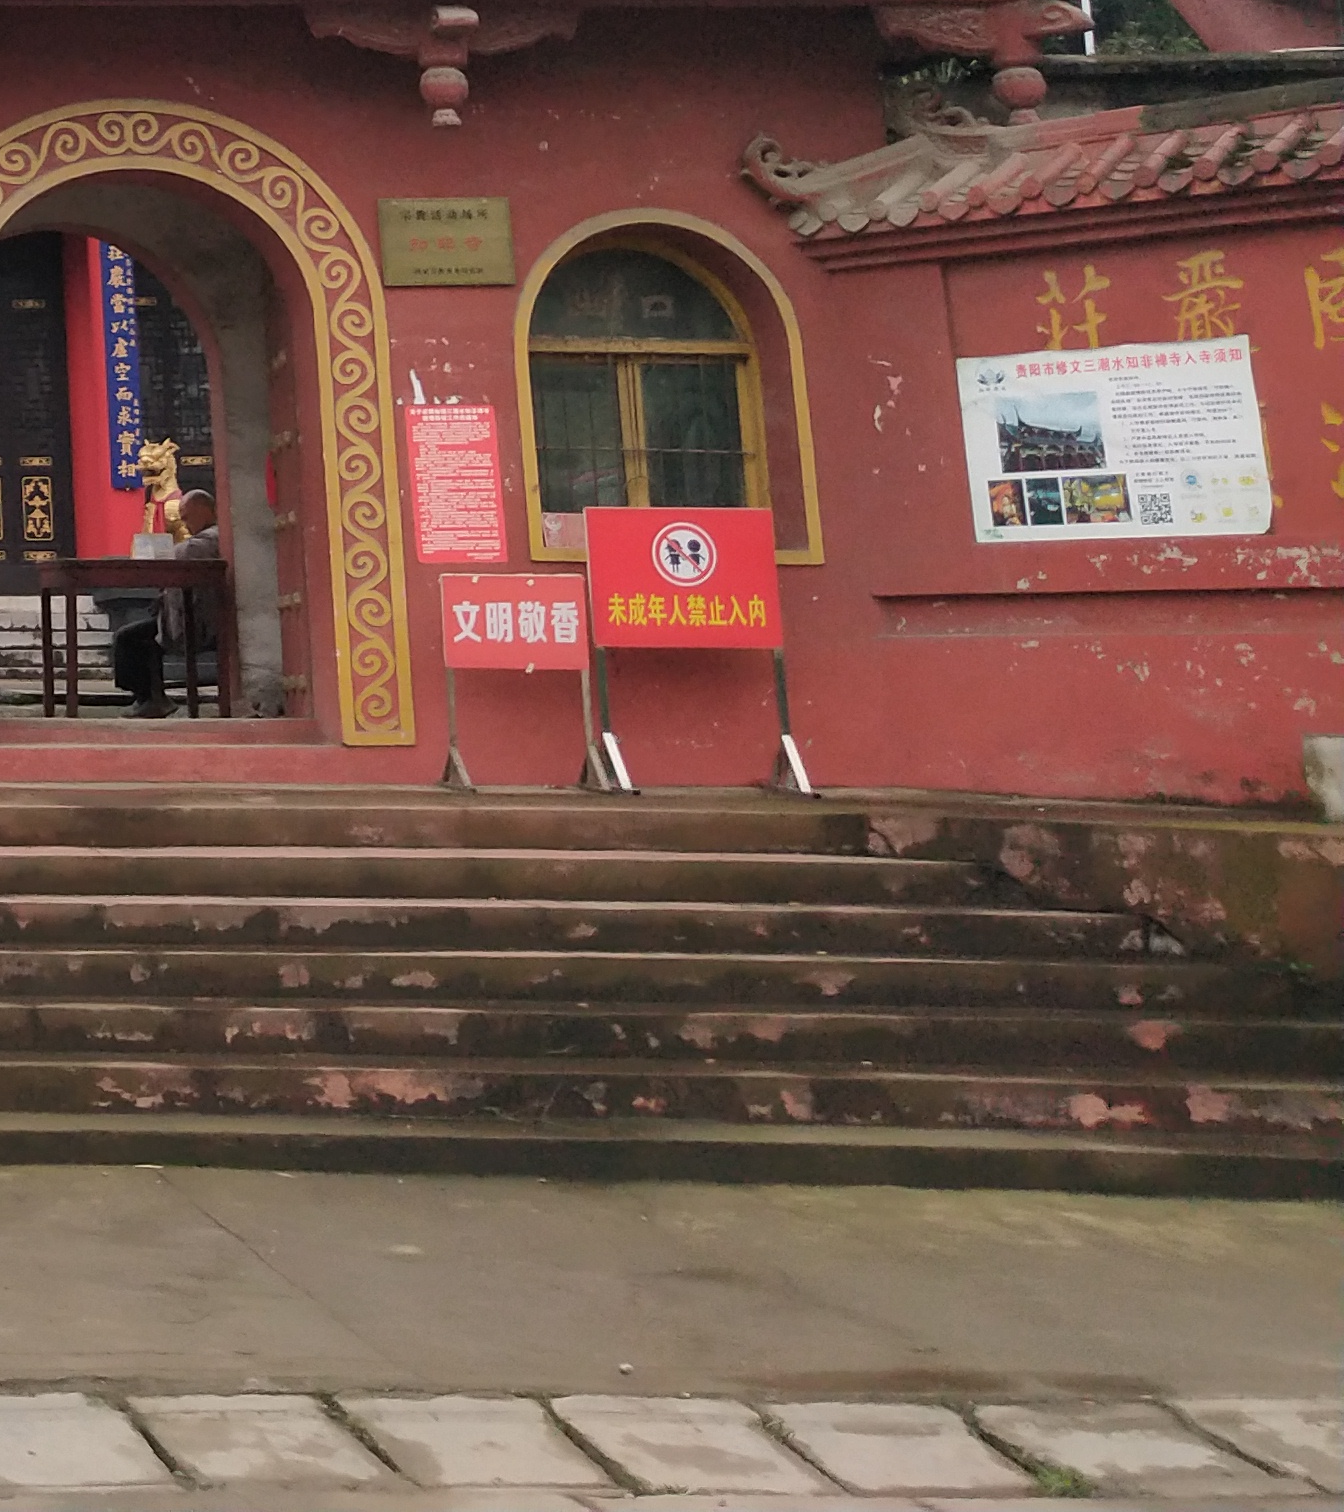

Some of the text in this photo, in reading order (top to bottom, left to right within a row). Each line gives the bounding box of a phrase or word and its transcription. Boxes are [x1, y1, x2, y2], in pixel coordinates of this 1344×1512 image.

[452, 601, 578, 643] 文明敬香
[608, 593, 766, 627] 未成年人禁止入内
